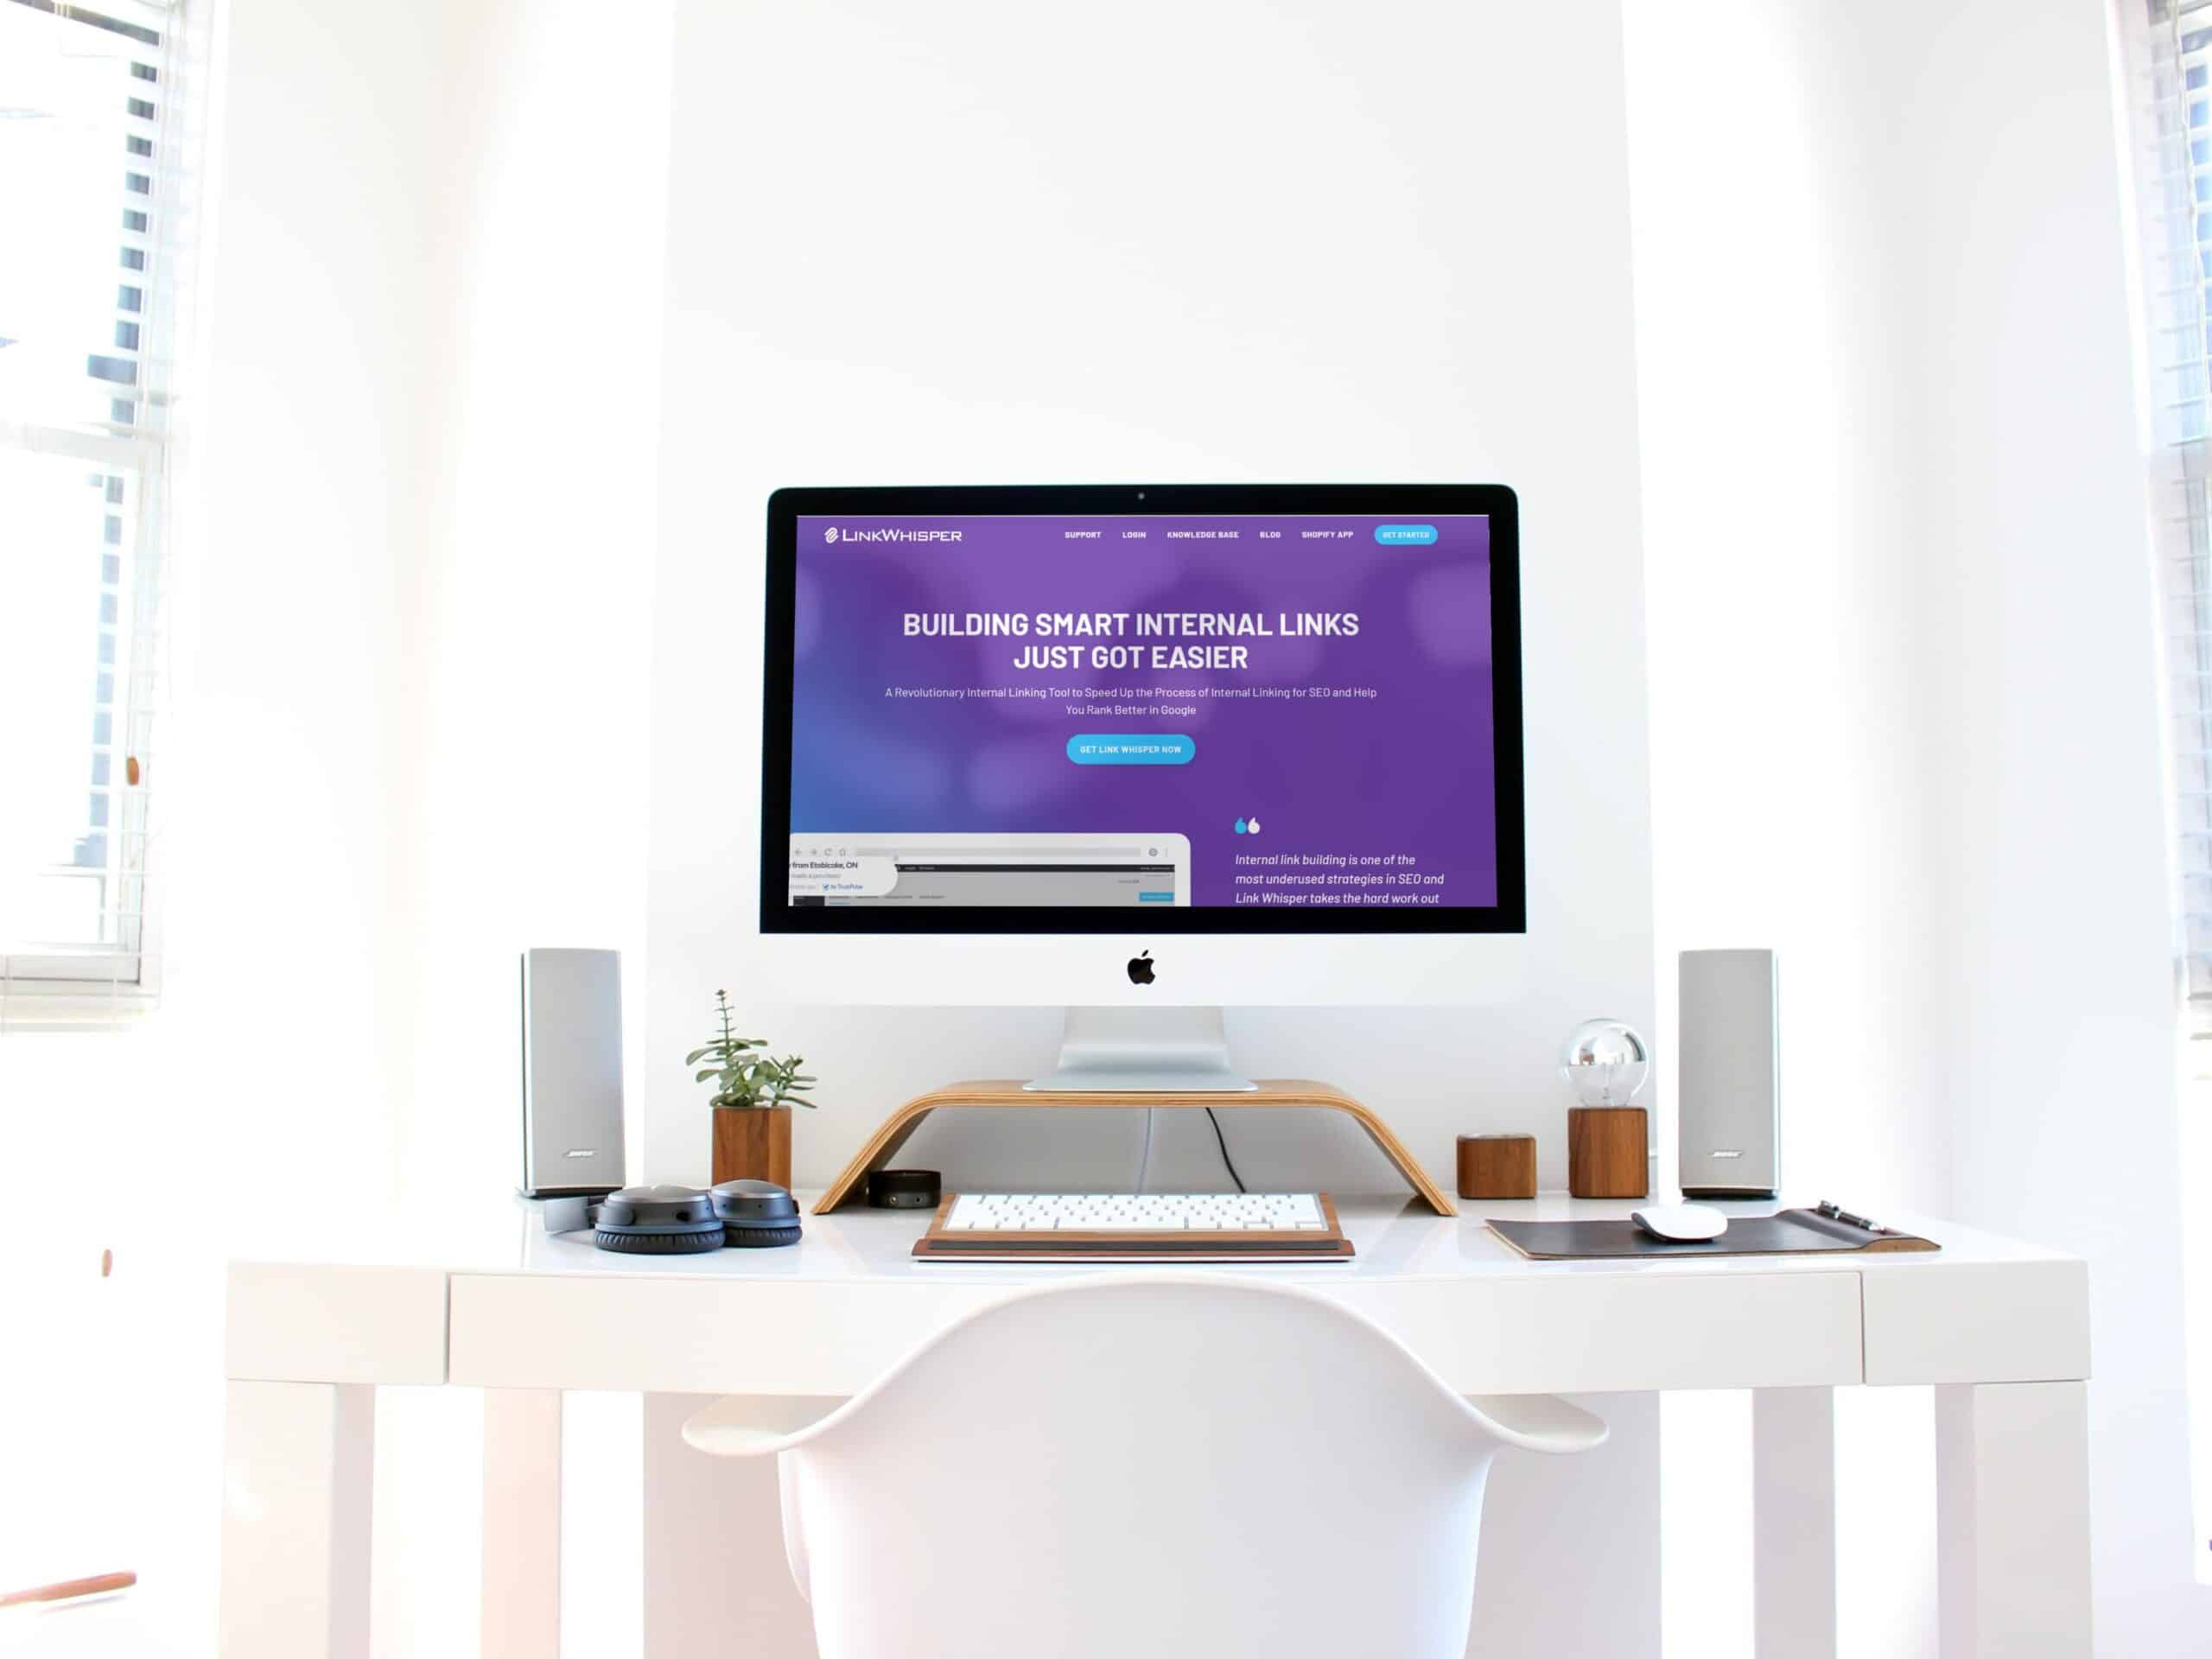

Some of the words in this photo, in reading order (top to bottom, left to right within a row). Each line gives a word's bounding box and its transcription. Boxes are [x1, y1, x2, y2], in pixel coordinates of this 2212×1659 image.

[903, 613, 1029, 637] BUILDING
[1034, 613, 1130, 637] SMART
[1136, 613, 1274, 636] INTERNAL
[1280, 613, 1359, 637] LINKS
[1013, 645, 1085, 670] JUST
[1091, 645, 1145, 669] GOT
[1152, 645, 1249, 670] EASIER
[885, 688, 893, 697] A
[894, 688, 965, 699] Revolutionary
[967, 688, 1007, 697] Internal
[1008, 688, 1046, 699] Linking
[1048, 688, 1071, 697] Tool
[1071, 688, 1083, 697] to
[1084, 688, 1118, 699] Speed
[1120, 688, 1135, 699] Up
[1136, 688, 1153, 697] the
[1155, 688, 1197, 697] Process
[1198, 688, 1209, 697] of
[1211, 688, 1250, 697] Internal
[1252, 688, 1290, 699] Linking
[1292, 688, 1307, 697] for
[1309, 688, 1331, 697] SEO
[1332, 688, 1351, 697] and
[1353, 688, 1377, 699] Help
[1066, 705, 1085, 715] You
[1087, 705, 1112, 715] Rank
[1115, 705, 1147, 715] Better
[1149, 705, 1160, 715] in
[1161, 705, 1197, 716] Google
[1079, 746, 1097, 754] GET
[1099, 746, 1119, 754] LINK
[1121, 746, 1160, 754] WHISPER
[1162, 746, 1182, 754] NOW
[846, 861, 858, 870] ON
[1235, 854, 1278, 866] Internal
[1280, 854, 1300, 866] link
[1301, 854, 1346, 868] building
[1349, 854, 1358, 866] is
[1360, 856, 1382, 866] one
[1382, 854, 1396, 866] of
[1397, 854, 1416, 866] the
[1235, 874, 1264, 885] most
[1265, 873, 1325, 885] underused
[1326, 873, 1384, 887] strategies
[1385, 873, 1396, 885] in
[1397, 873, 1422, 885] SEO
[1423, 873, 1445, 885] and
[1235, 892, 1260, 904] Link
[1262, 892, 1308, 906] Whisper
[1310, 892, 1341, 904] takes
[1343, 892, 1362, 904] the
[1363, 892, 1389, 904] hard
[1391, 892, 1419, 904] work
[1421, 893, 1440, 904] out
